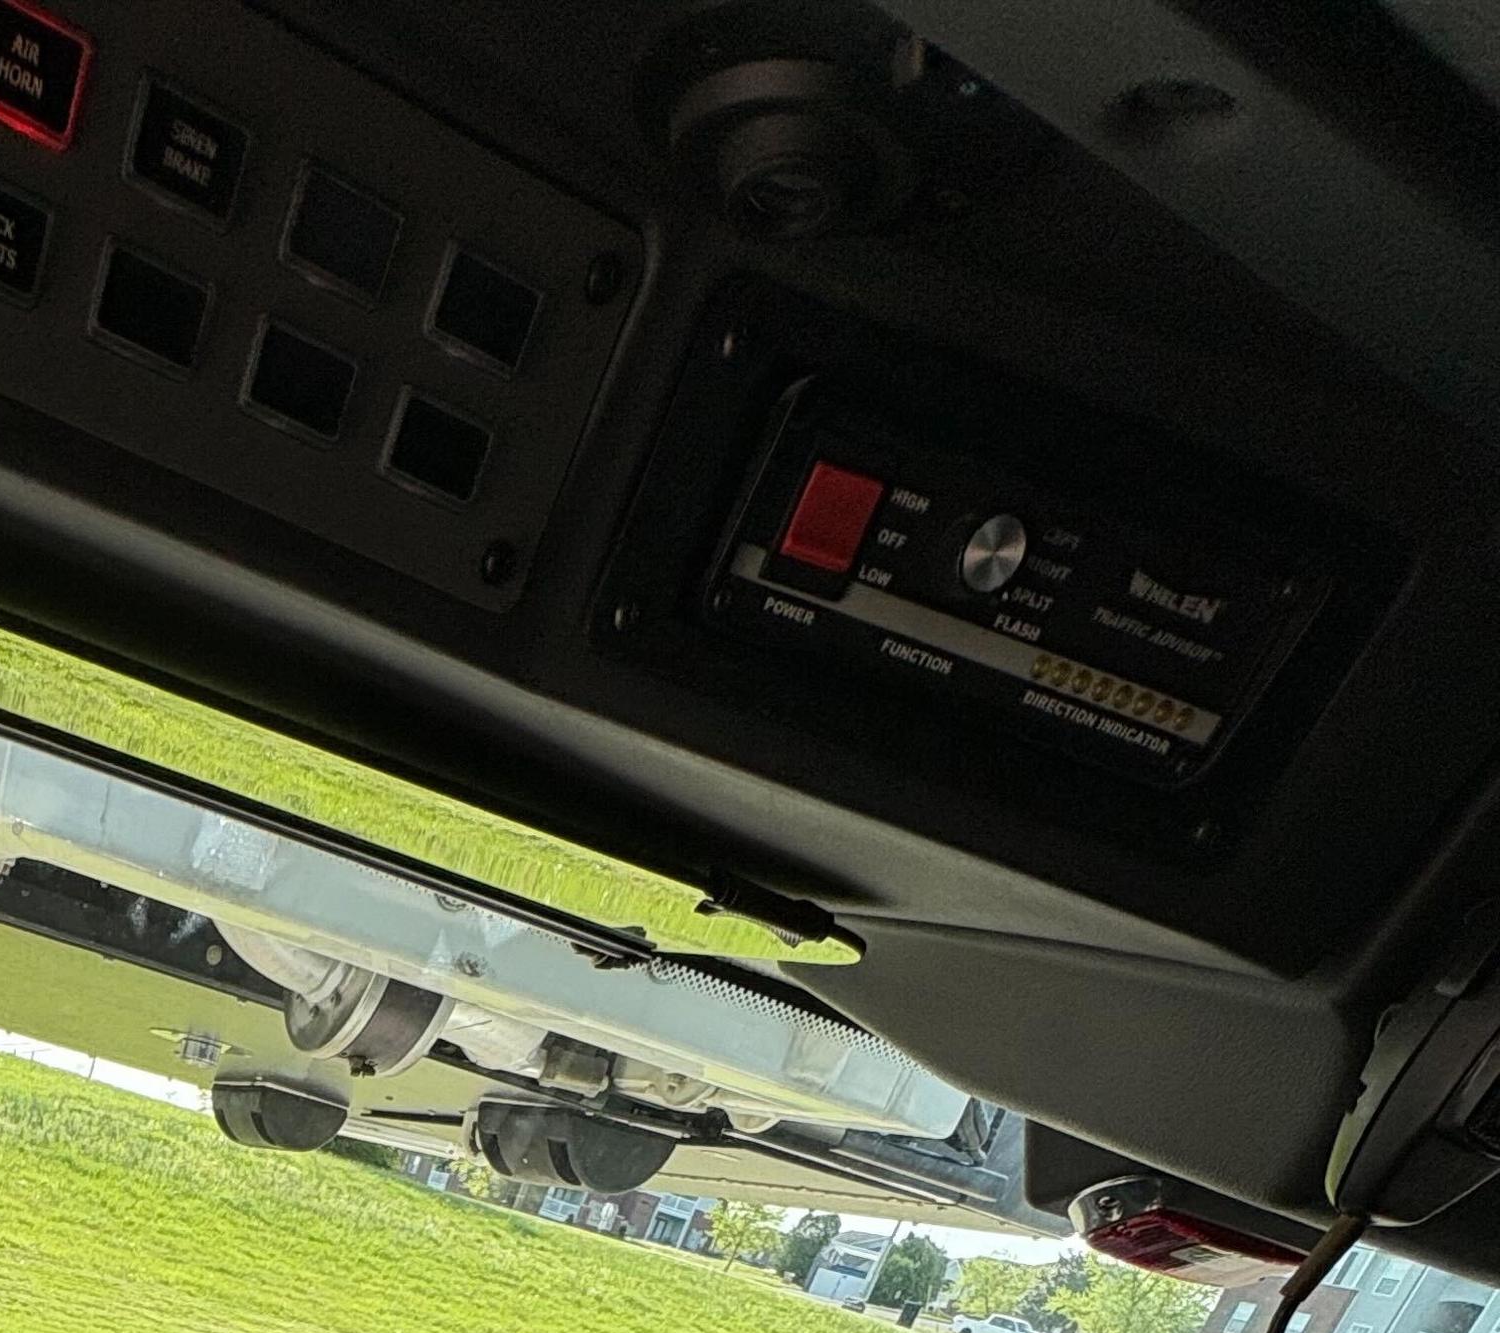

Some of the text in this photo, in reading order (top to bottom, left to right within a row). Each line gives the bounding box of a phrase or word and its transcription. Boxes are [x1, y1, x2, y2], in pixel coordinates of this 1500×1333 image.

[11, 32, 40, 66] AIR
[890, 488, 931, 513] HIGH
[877, 528, 908, 550] OFF
[857, 563, 892, 587] LOW
[763, 596, 816, 626] POWER
[993, 613, 1042, 643] FLASH
[880, 638, 954, 676] FUNCTION
[1023, 689, 1172, 756] DIRECTION INDICATOR
